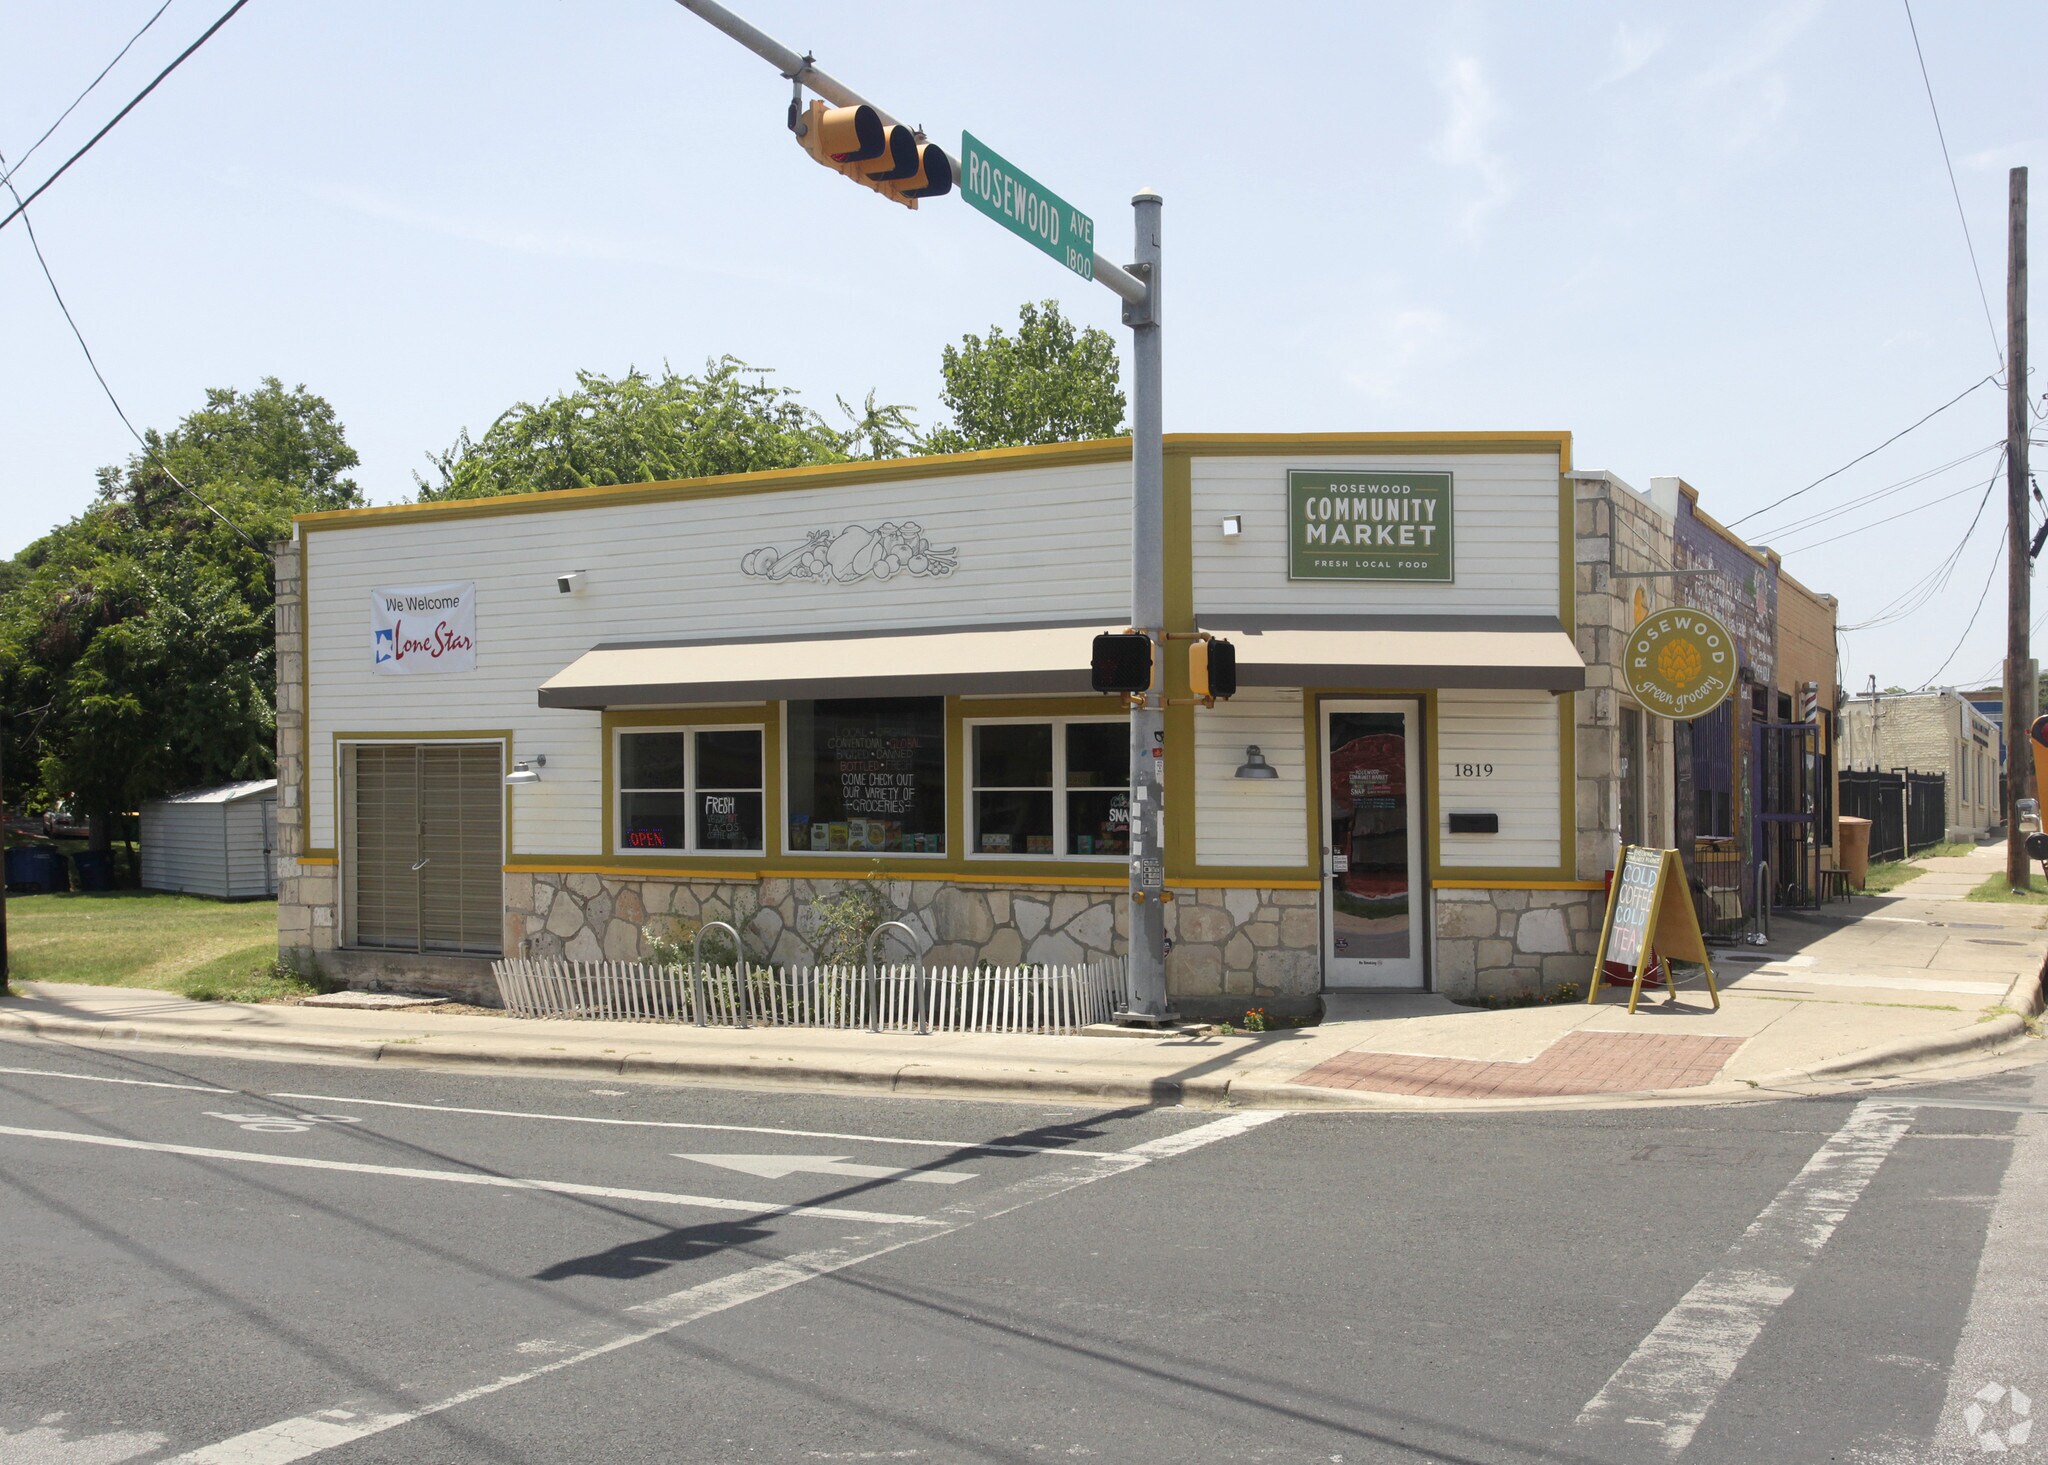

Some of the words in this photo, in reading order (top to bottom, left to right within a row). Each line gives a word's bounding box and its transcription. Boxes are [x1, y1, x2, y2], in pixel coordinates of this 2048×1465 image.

[969, 150, 1060, 246] ROSEWOOD
[1069, 210, 1092, 244] AVE
[1066, 245, 1091, 279] 1800
[1330, 484, 1411, 494] ROSEWOOD
[1305, 497, 1437, 522] COMMUNITY
[1305, 523, 1436, 546] MARKET
[1355, 560, 1391, 568] LOCAL
[1398, 561, 1428, 569] FOOD
[386, 598, 404, 612] We
[405, 596, 460, 611] Welcome
[1635, 617, 1725, 667] ROSEWOOD
[1636, 681, 1674, 705] green
[1674, 675, 1724, 712] grocery
[840, 761, 879, 772] BOTTLED
[1455, 763, 1493, 777] 1819
[841, 773, 867, 786] COME
[869, 773, 894, 786] CHECK
[896, 773, 914, 786] OUT
[842, 786, 860, 798] OUR
[865, 787, 898, 800] VARIETY
[902, 787, 916, 801] OF
[705, 796, 735, 815] FRESH
[852, 799, 905, 813] GROCERIES
[1109, 808, 1129, 822] SNA
[630, 832, 663, 846] OPEN
[1623, 864, 1658, 888] COLD
[1619, 884, 1654, 912] COFFEE
[1615, 906, 1645, 926] COLD
[1613, 926, 1636, 955] TEA
